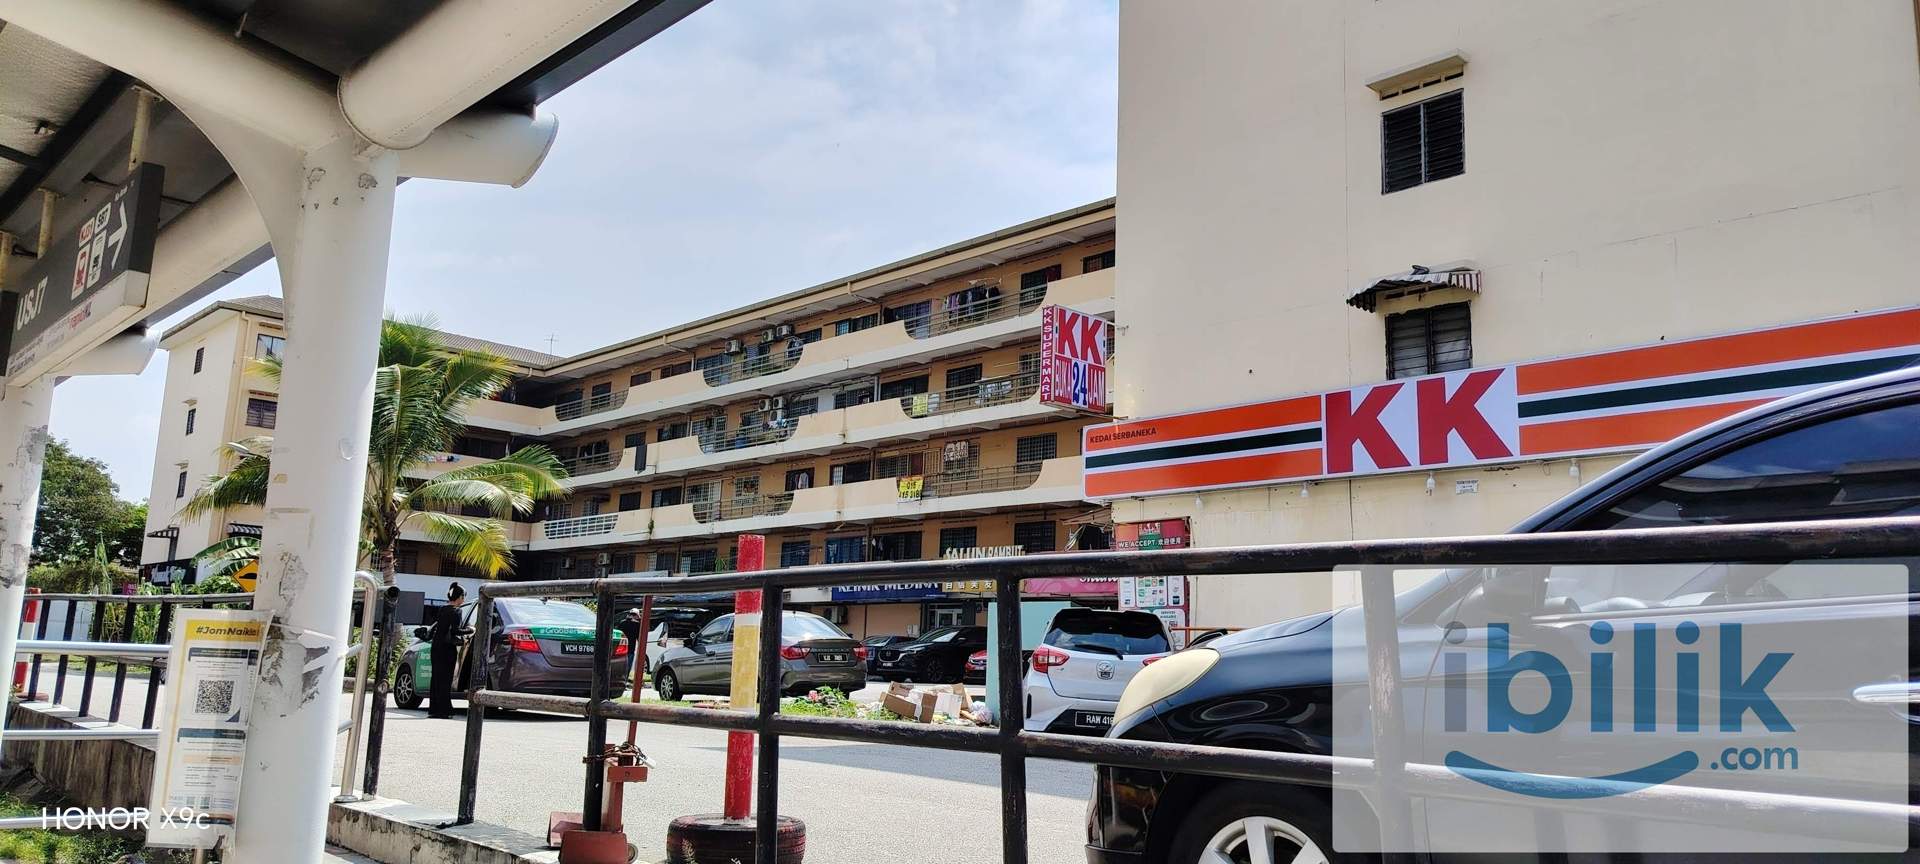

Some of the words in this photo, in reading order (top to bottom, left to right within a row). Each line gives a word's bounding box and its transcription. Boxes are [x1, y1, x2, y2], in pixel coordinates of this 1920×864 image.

[16, 276, 48, 331] USJ7
[1058, 309, 1103, 365] KK
[1073, 361, 1088, 405] 24
[1088, 369, 1105, 407] JAM
[1089, 434, 1112, 444] KEDAI
[1112, 427, 1157, 440] SERBANEKA
[1325, 367, 1515, 475] KK
[565, 644, 577, 652] VCH
[1086, 715, 1101, 725] RAW
